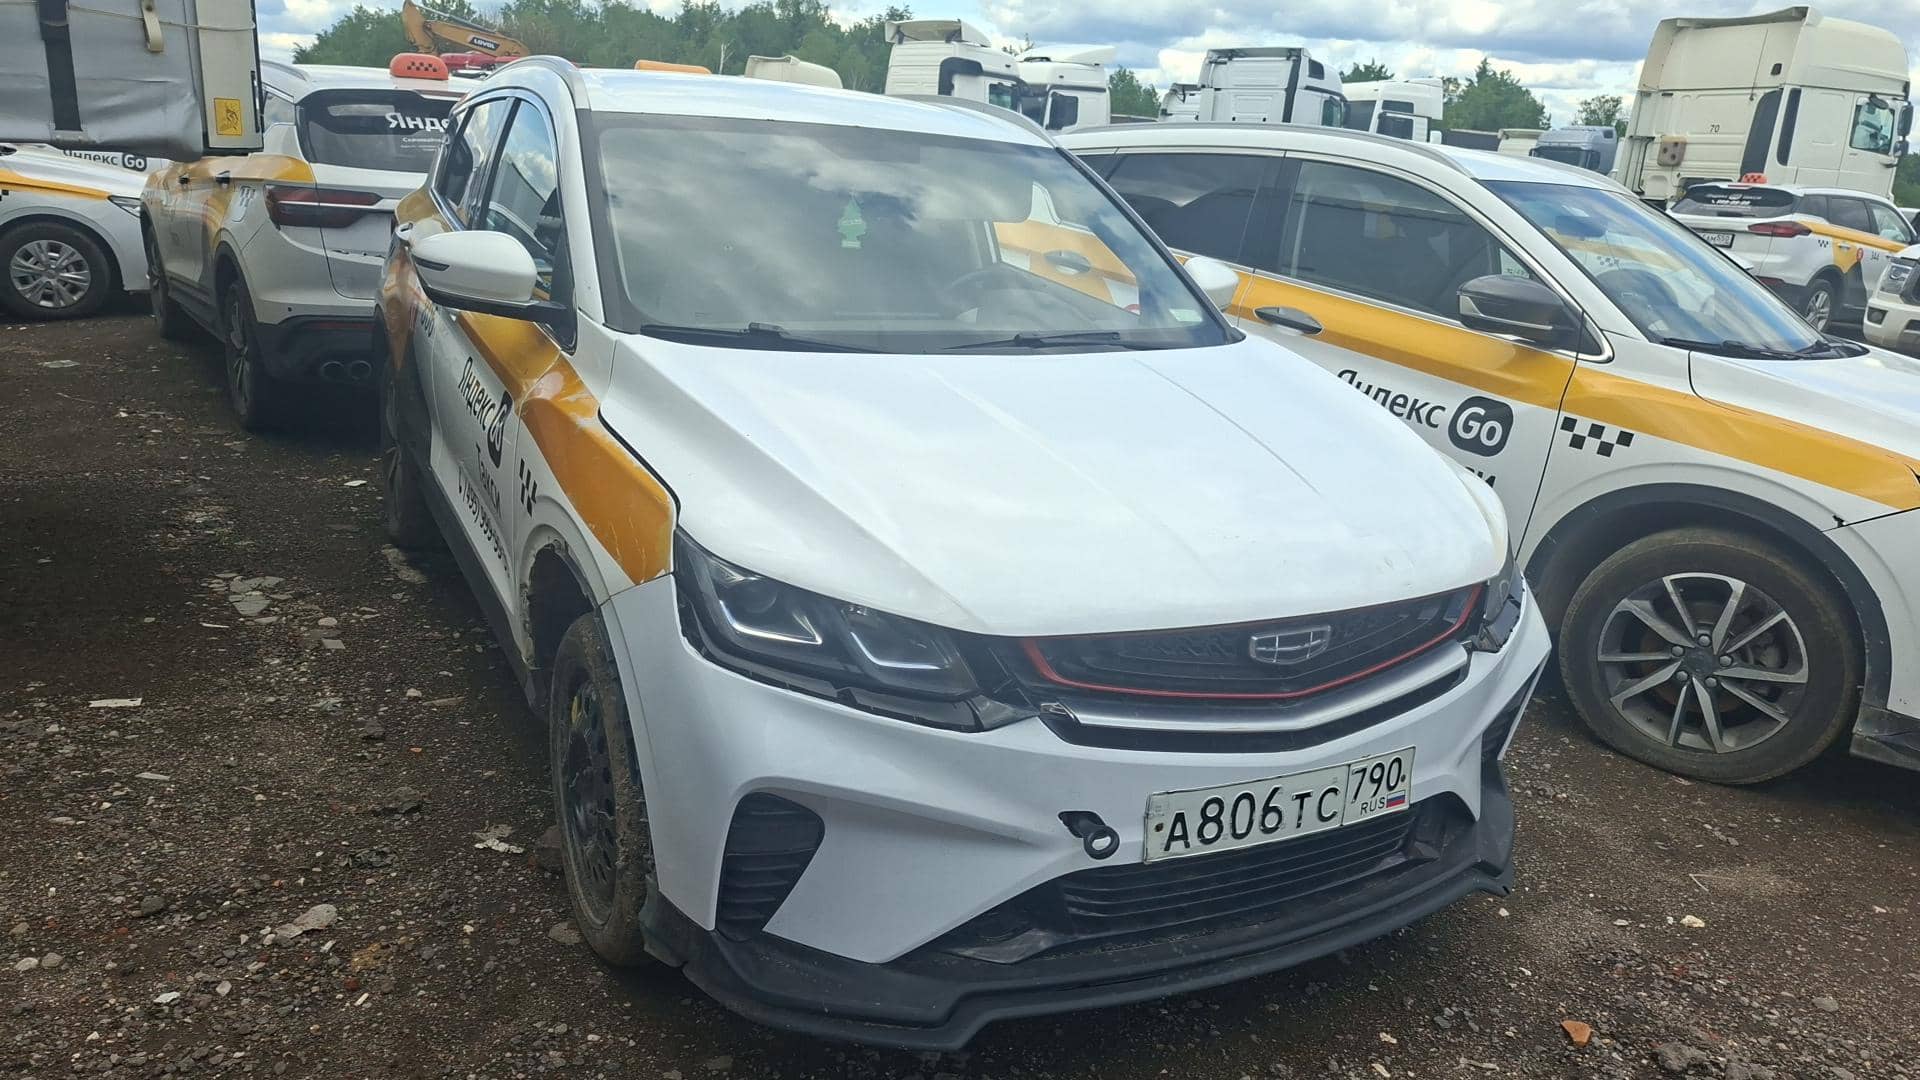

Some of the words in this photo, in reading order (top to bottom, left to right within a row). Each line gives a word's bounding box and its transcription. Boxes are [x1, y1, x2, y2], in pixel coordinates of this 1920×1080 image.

[123, 153, 146, 170] Go
[458, 355, 497, 432] Яндекс
[1454, 405, 1505, 448] Go
[1351, 756, 1402, 804] 790
[1360, 796, 1386, 816] RUS
